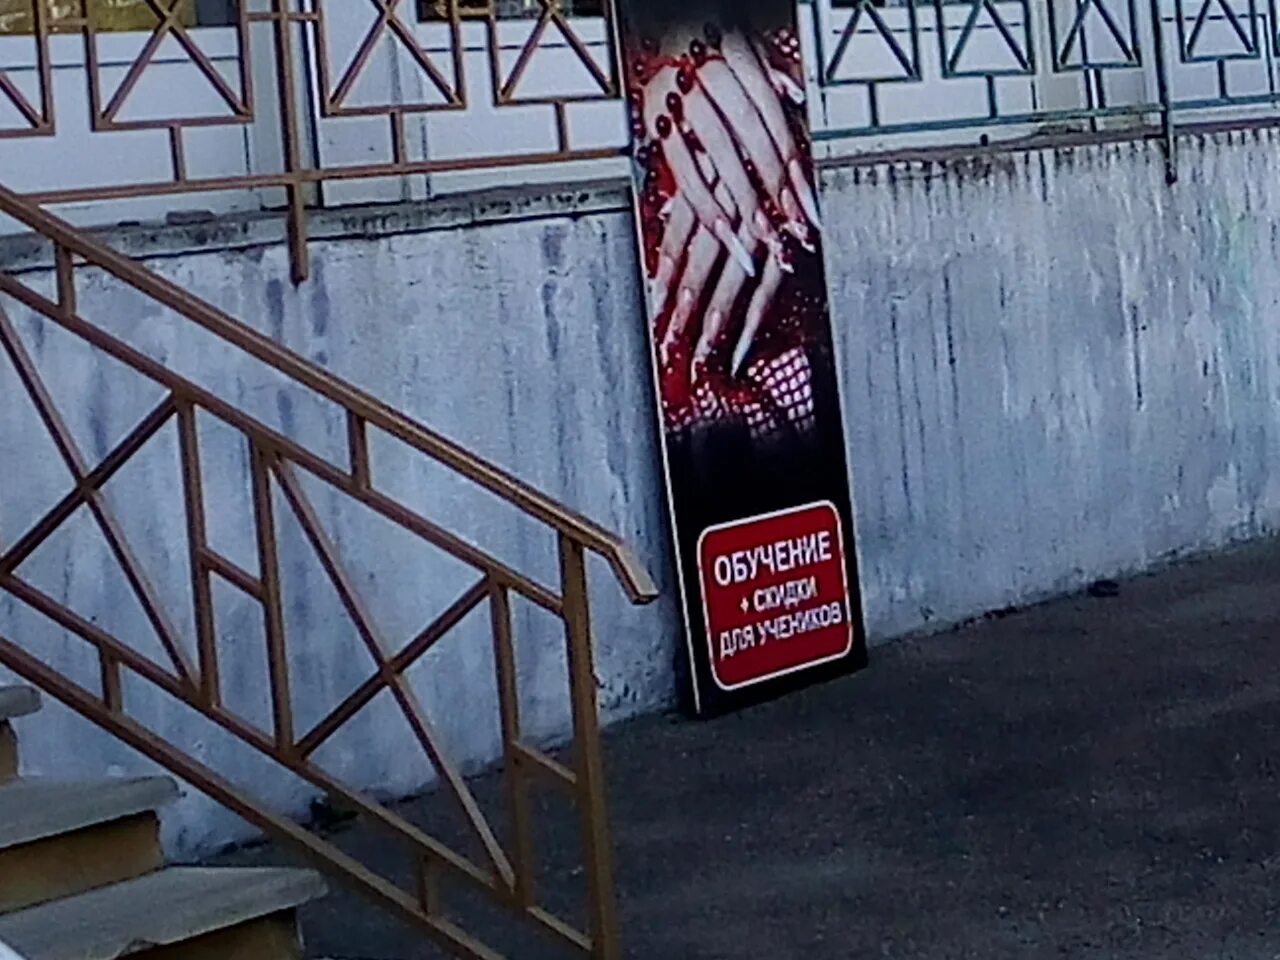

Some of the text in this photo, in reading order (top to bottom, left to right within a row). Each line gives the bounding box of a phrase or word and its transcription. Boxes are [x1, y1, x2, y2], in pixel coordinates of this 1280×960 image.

[713, 530, 833, 587] ОБУЧЕНИЕ
[752, 575, 819, 612] СКИДКИ
[719, 600, 843, 662] ДЛЯ УЧЕНИКОВ
